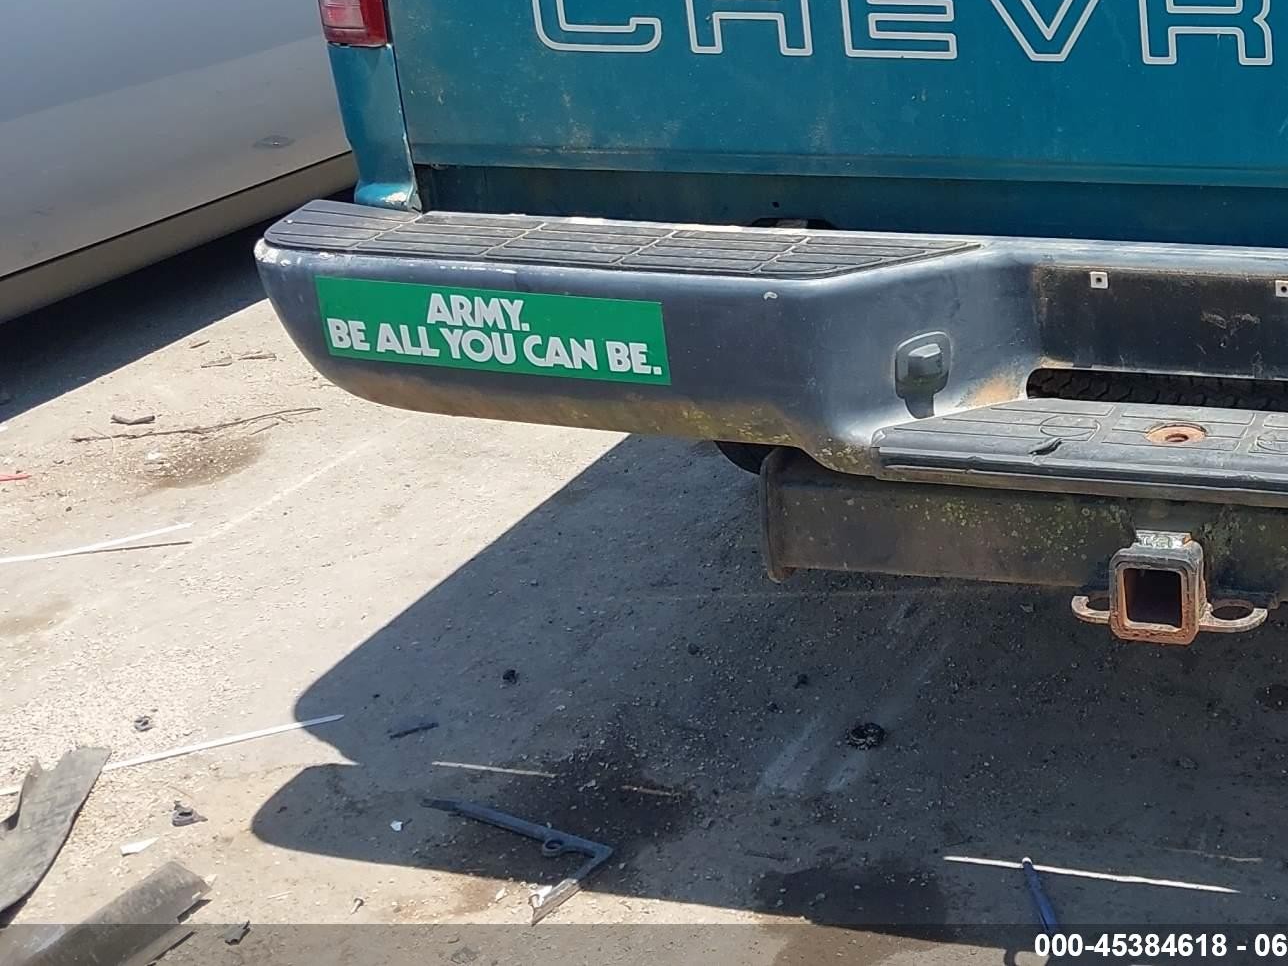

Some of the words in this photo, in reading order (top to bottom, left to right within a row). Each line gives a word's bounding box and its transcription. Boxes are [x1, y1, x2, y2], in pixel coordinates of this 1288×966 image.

[427, 293, 530, 331] ARMY.
[327, 318, 370, 351] BE
[377, 323, 440, 357] ALL
[440, 328, 516, 364] YOU
[523, 335, 598, 371] CAN
[606, 341, 662, 375] BE.
